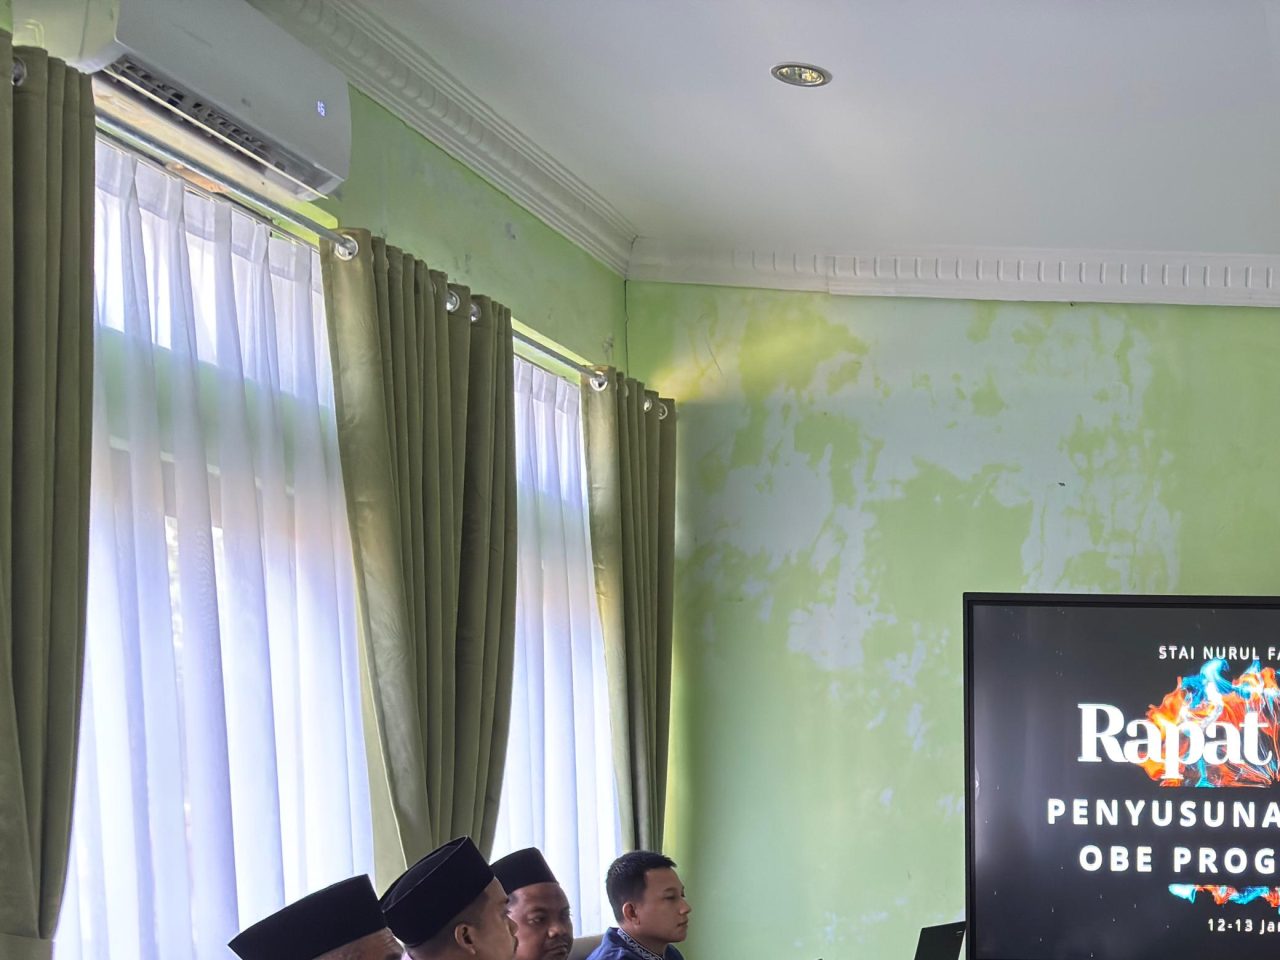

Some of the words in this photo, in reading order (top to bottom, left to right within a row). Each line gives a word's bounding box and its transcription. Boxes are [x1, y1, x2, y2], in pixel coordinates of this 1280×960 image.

[1158, 645, 1195, 660] STAI
[1203, 646, 1260, 661] NURUL
[1077, 703, 1274, 779] Rapat
[1078, 846, 1153, 873] OBE
[1207, 918, 1254, 932] 12-13
